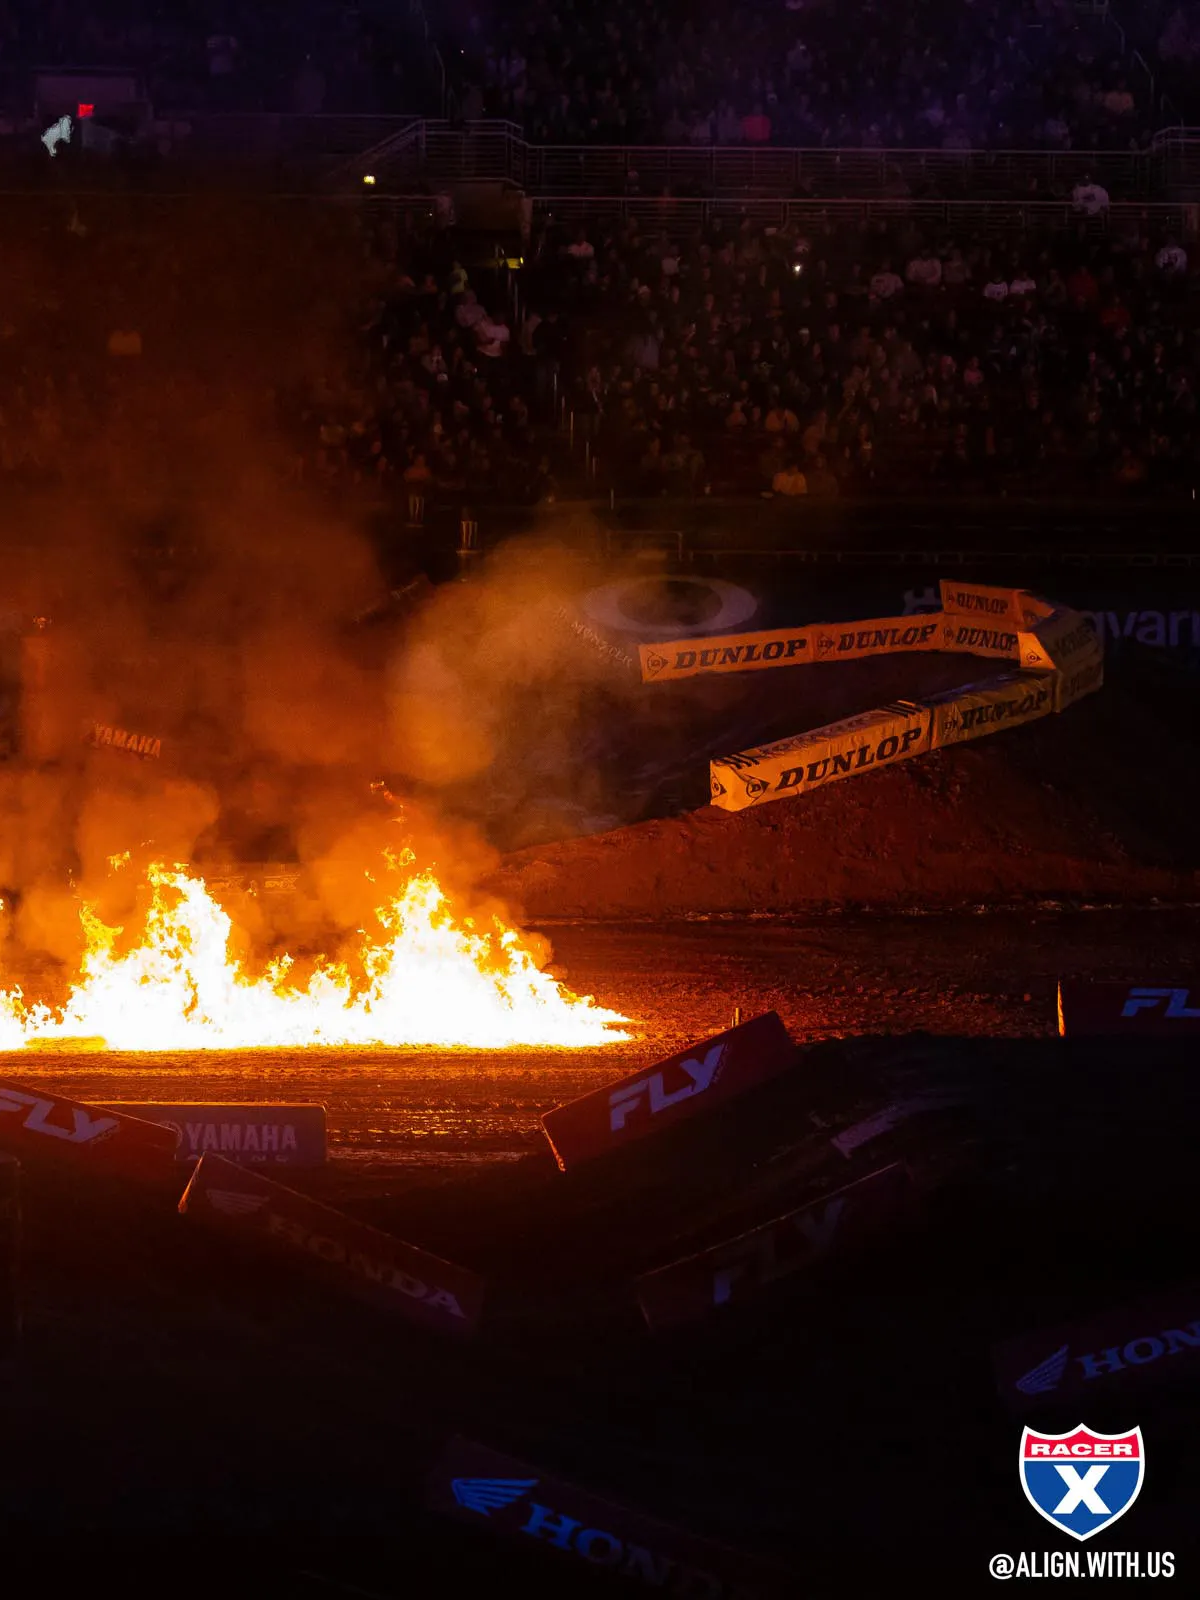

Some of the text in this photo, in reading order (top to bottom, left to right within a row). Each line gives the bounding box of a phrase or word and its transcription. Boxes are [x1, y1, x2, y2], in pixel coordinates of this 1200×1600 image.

[956, 592, 1009, 614] DUNLOP
[836, 623, 938, 652] DUNLOP
[954, 626, 1018, 651] DUNLOP
[673, 638, 808, 670] DUNLOP
[774, 727, 923, 791] DUNLOP
[609, 1043, 725, 1132] FLY
[185, 1123, 297, 1150] YAMAHA
[519, 1501, 760, 1600] HOND
